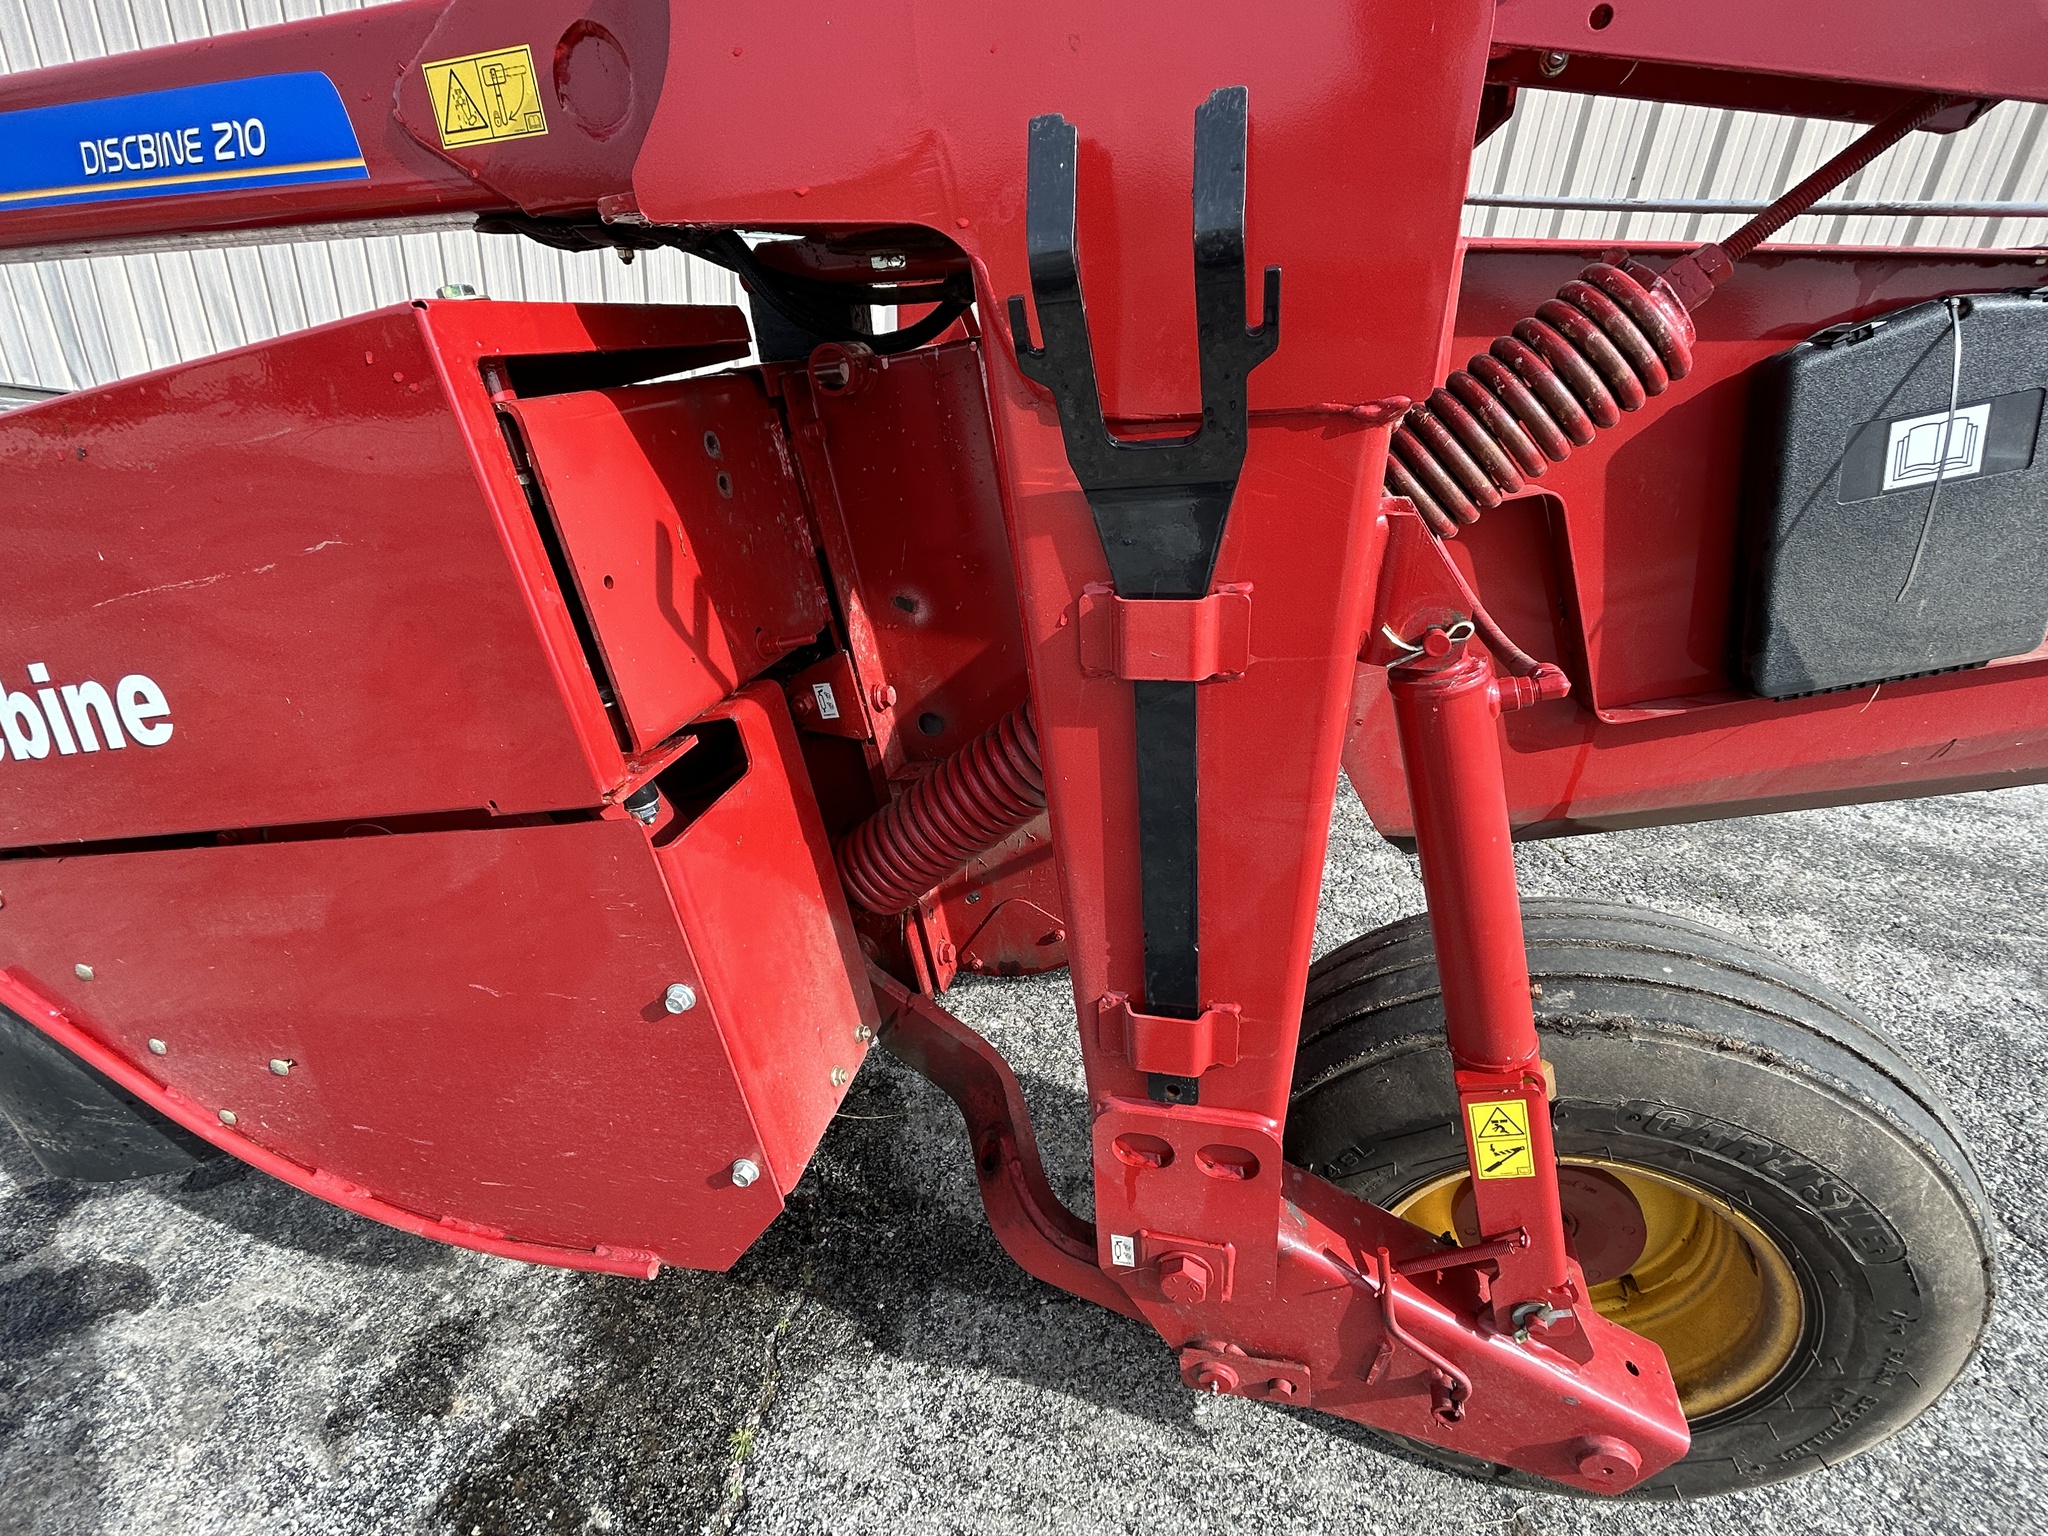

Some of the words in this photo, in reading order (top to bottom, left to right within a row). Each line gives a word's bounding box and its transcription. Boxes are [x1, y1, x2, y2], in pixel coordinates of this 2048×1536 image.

[79, 127, 204, 176] DISCBINE
[211, 117, 267, 161] 210
[0, 662, 174, 761] bine
[1645, 1109, 1899, 1251] CARLISLE
